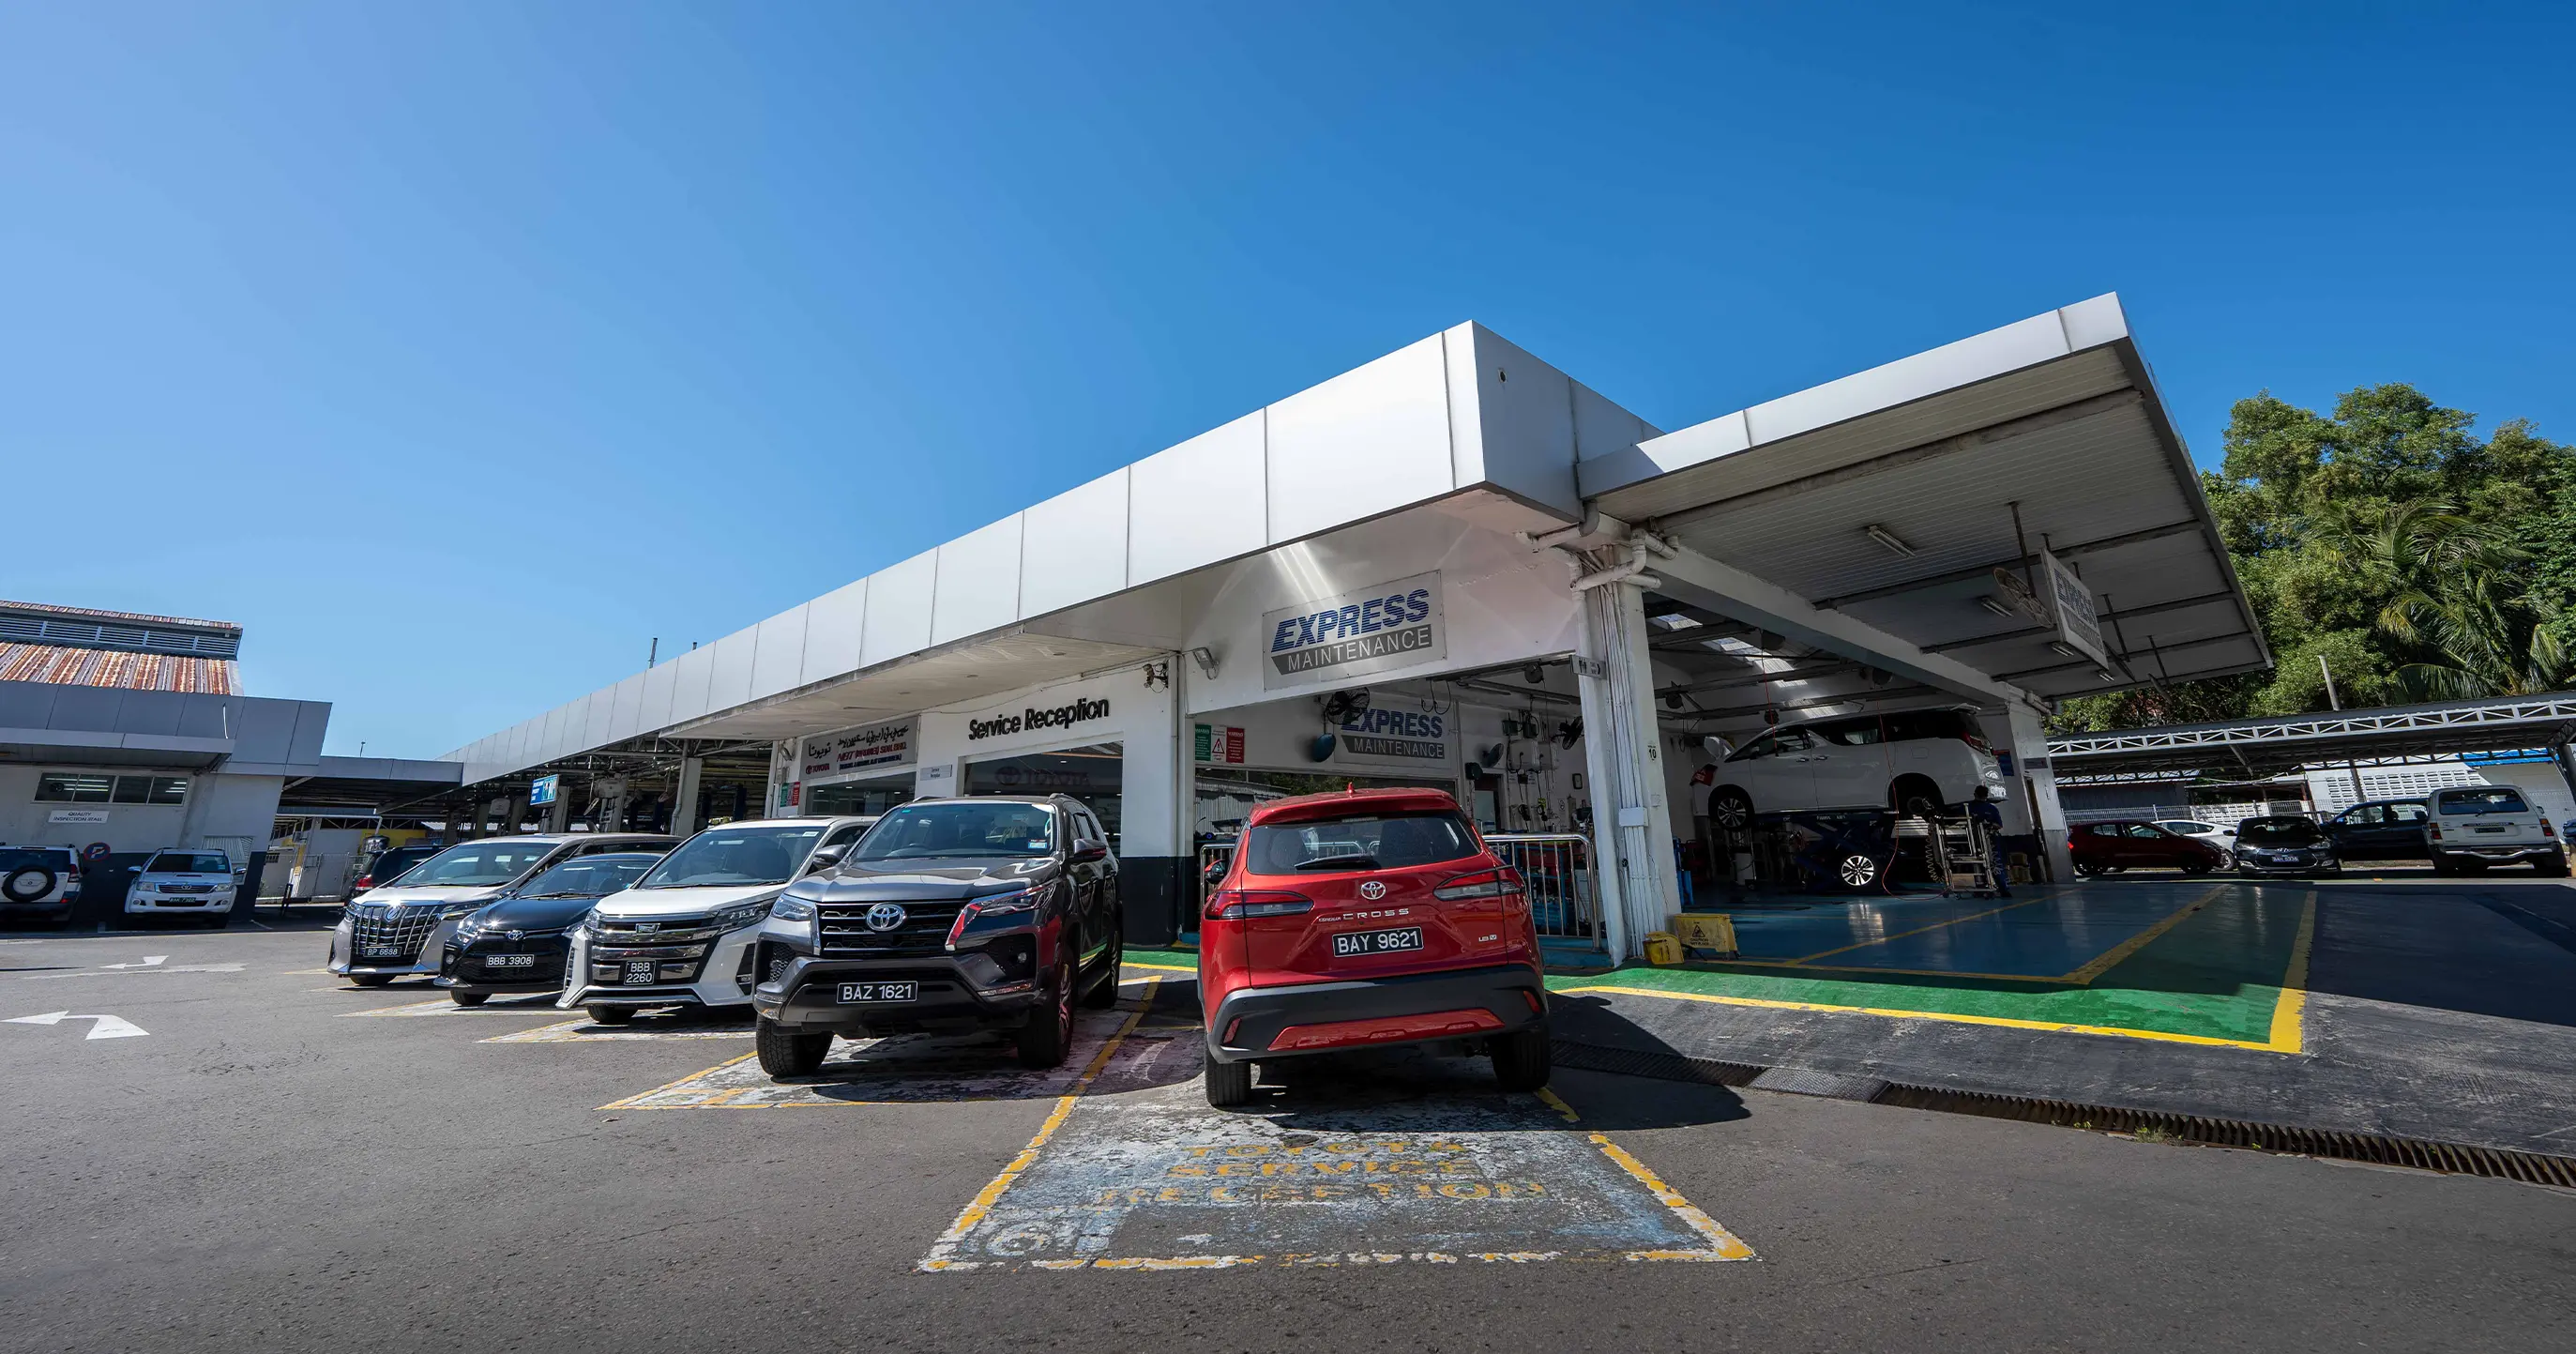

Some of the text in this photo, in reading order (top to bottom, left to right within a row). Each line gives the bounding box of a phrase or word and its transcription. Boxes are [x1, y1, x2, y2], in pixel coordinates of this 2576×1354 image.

[1270, 588, 1430, 653] EXPRESS
[1288, 627, 1431, 672] MAINTENANCE
[968, 697, 1110, 740] Service Reception
[1341, 708, 1443, 738] EXPRESS
[1354, 738, 1444, 758] MAINTENANCE
[1648, 748, 1657, 759] 10
[812, 763, 830, 773] TOYOTA
[1342, 907, 1410, 920] CROSS
[1337, 931, 1419, 953] BAY 9621
[367, 948, 377, 956] BP
[488, 956, 532, 966] BBB 3908
[630, 962, 651, 972] BBB
[626, 972, 653, 983] 2260
[842, 984, 914, 1000] BAZ 1621
[1182, 1141, 1466, 1158] TOYOTA
[1166, 1160, 1478, 1180] SERVICE
